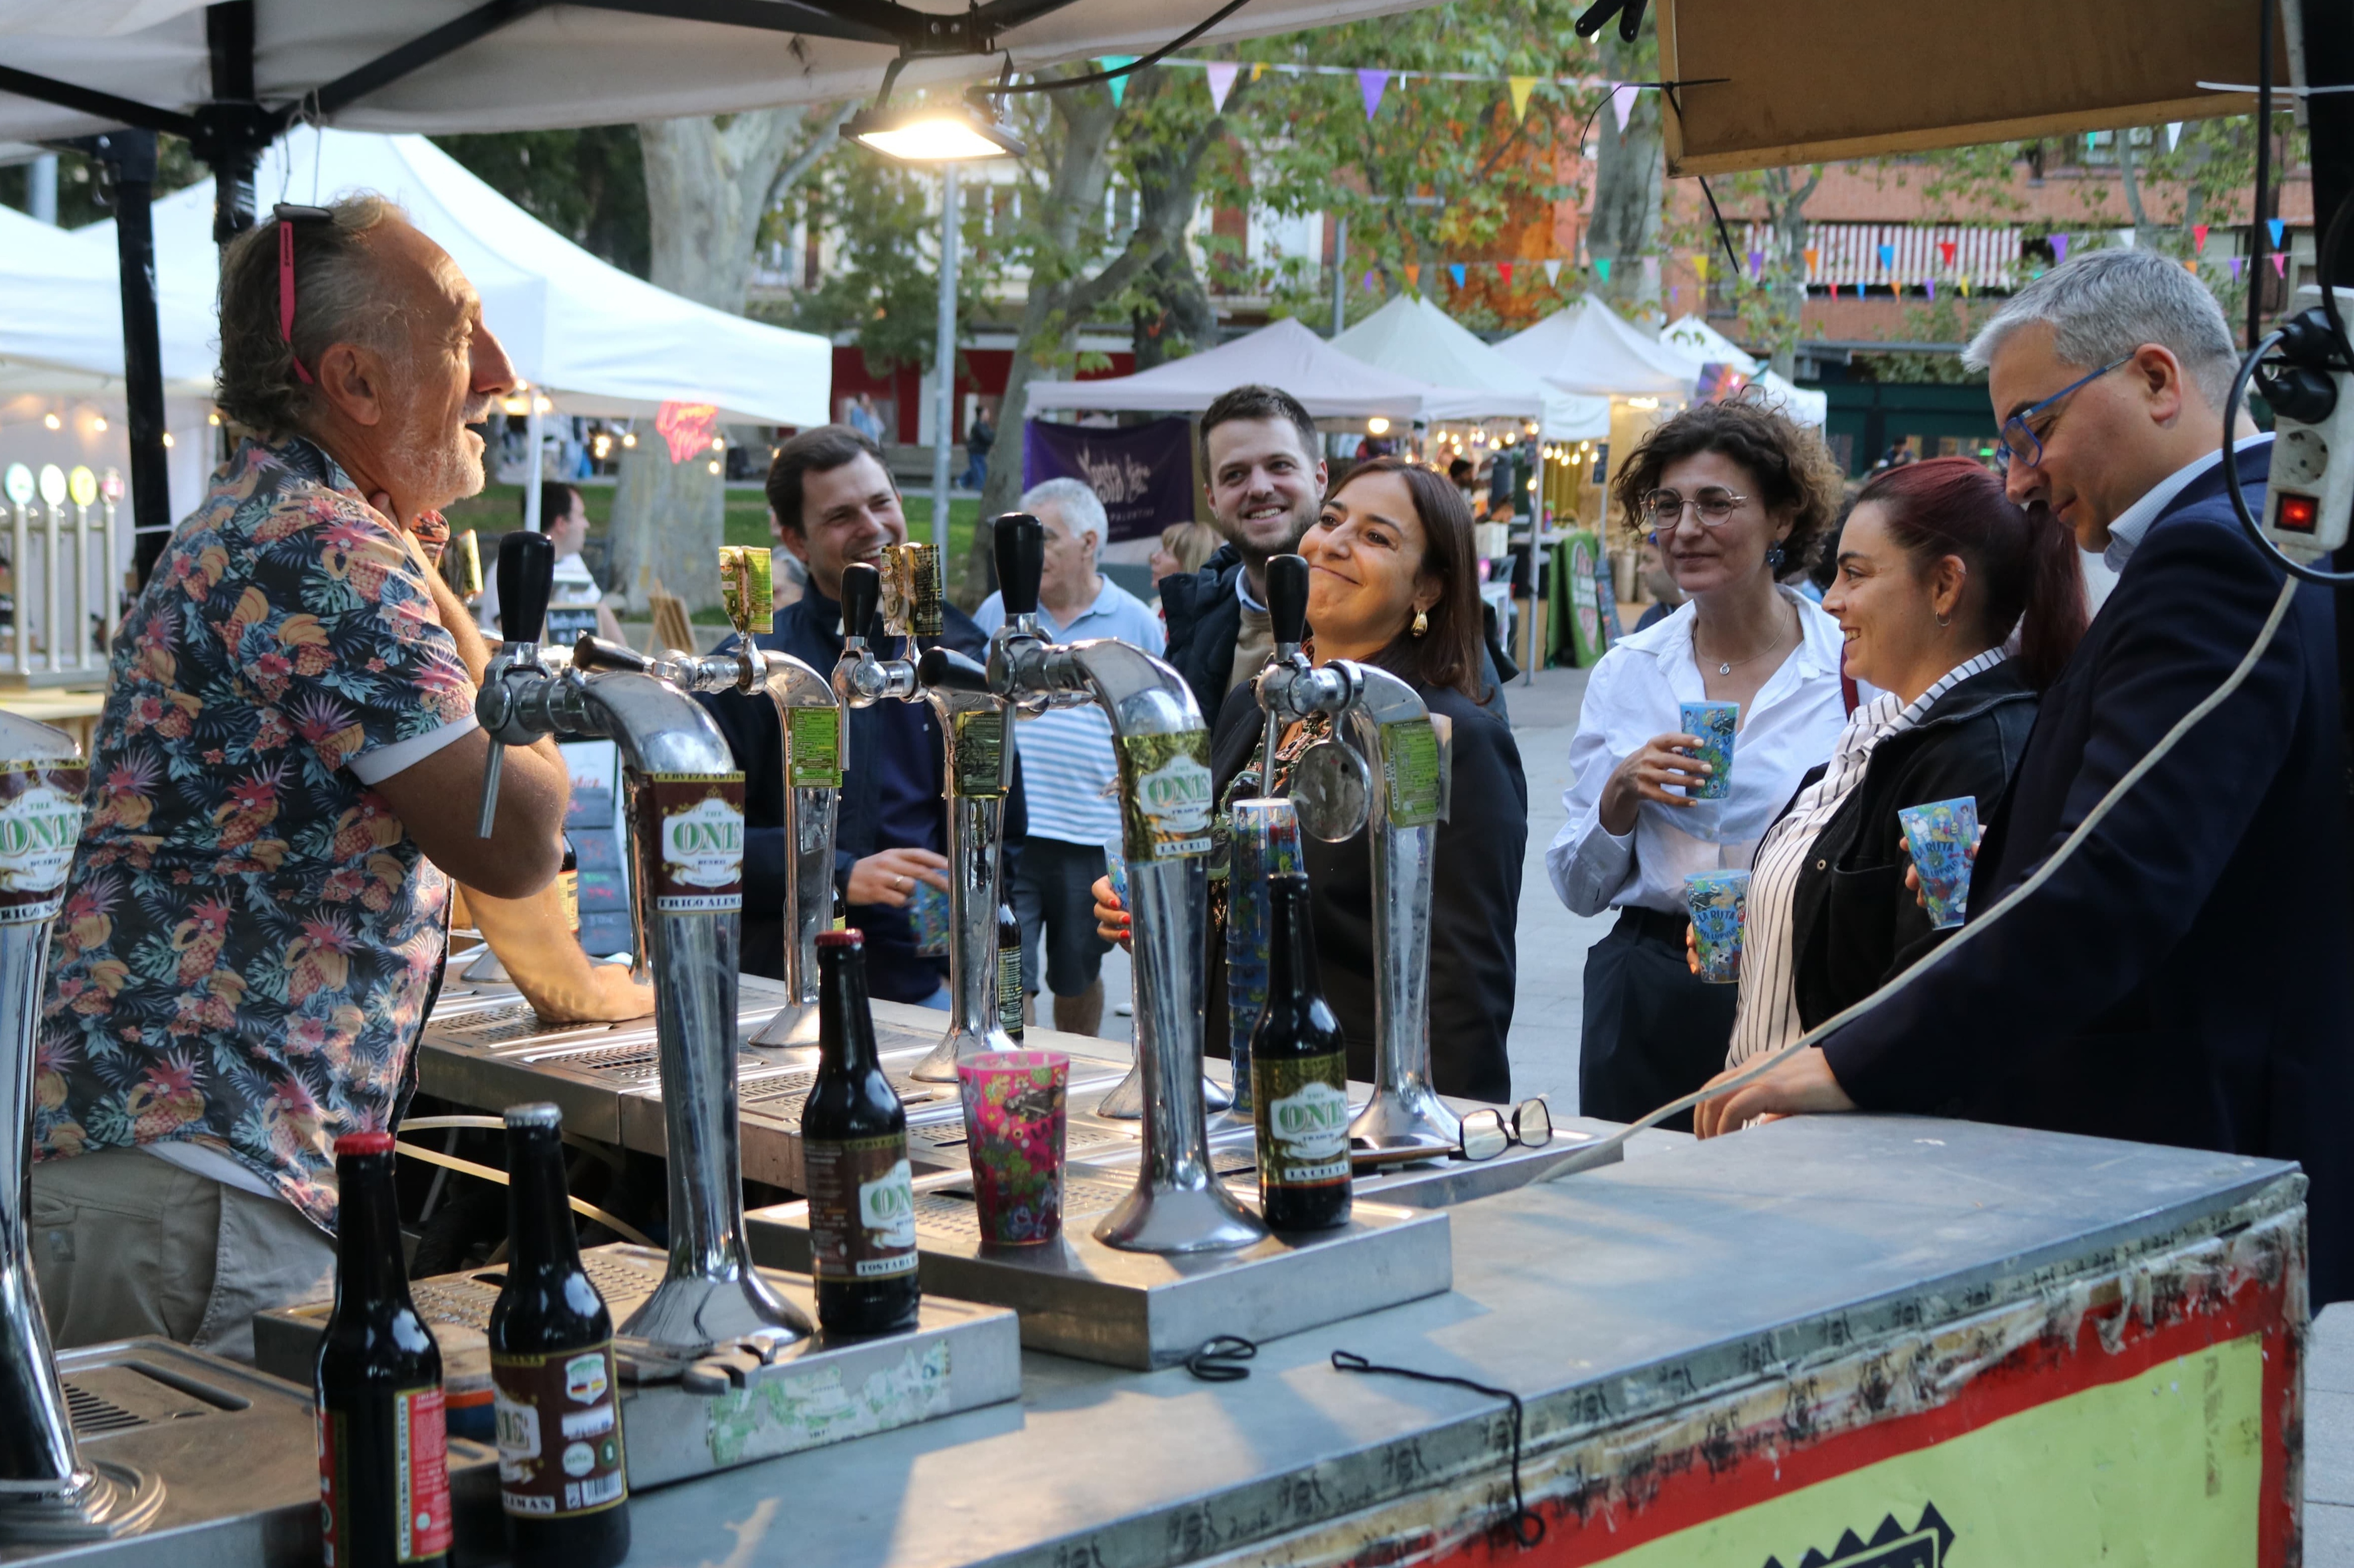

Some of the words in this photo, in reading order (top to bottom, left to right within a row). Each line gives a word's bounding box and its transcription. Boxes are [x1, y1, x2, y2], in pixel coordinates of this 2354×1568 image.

[1148, 774, 1212, 807] ONE
[0, 812, 82, 857] ONE
[673, 822, 743, 855] ONE
[1925, 840, 1954, 852] RUTA
[658, 898, 704, 908] TRIGO
[1697, 912, 1708, 923] LA
[1710, 910, 1735, 921] RUTA
[1279, 1099, 1348, 1134] ONE
